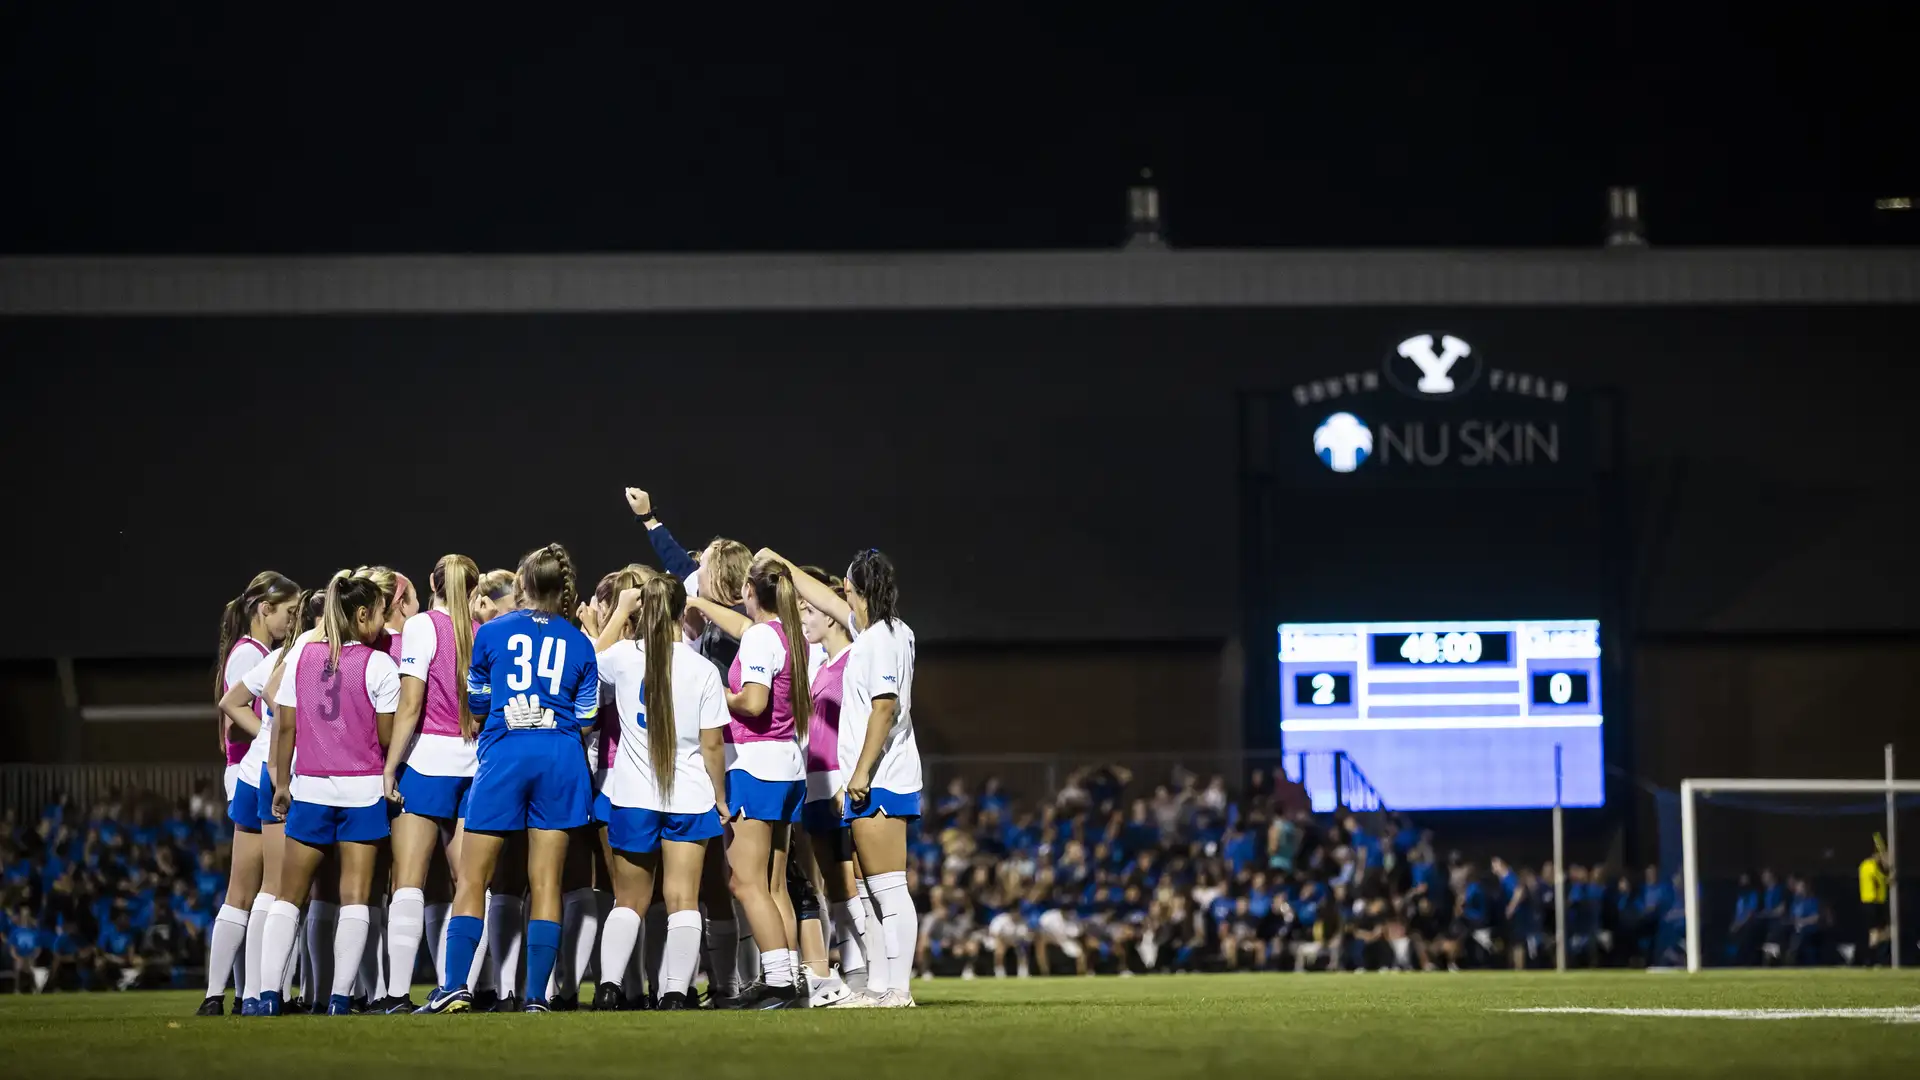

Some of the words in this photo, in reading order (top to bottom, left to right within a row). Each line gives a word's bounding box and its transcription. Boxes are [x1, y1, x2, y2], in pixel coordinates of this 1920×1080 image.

[1396, 333, 1472, 394] Y
[1292, 371, 1380, 406] SOUTH
[1489, 368, 1568, 403] FIELD
[1379, 421, 1450, 466] NU
[1458, 419, 1560, 466] SKIN
[506, 633, 567, 695] 34
[749, 665, 766, 674] WCC
[318, 668, 343, 721] 3
[1311, 673, 1336, 705] 2
[1549, 672, 1573, 704] 0
